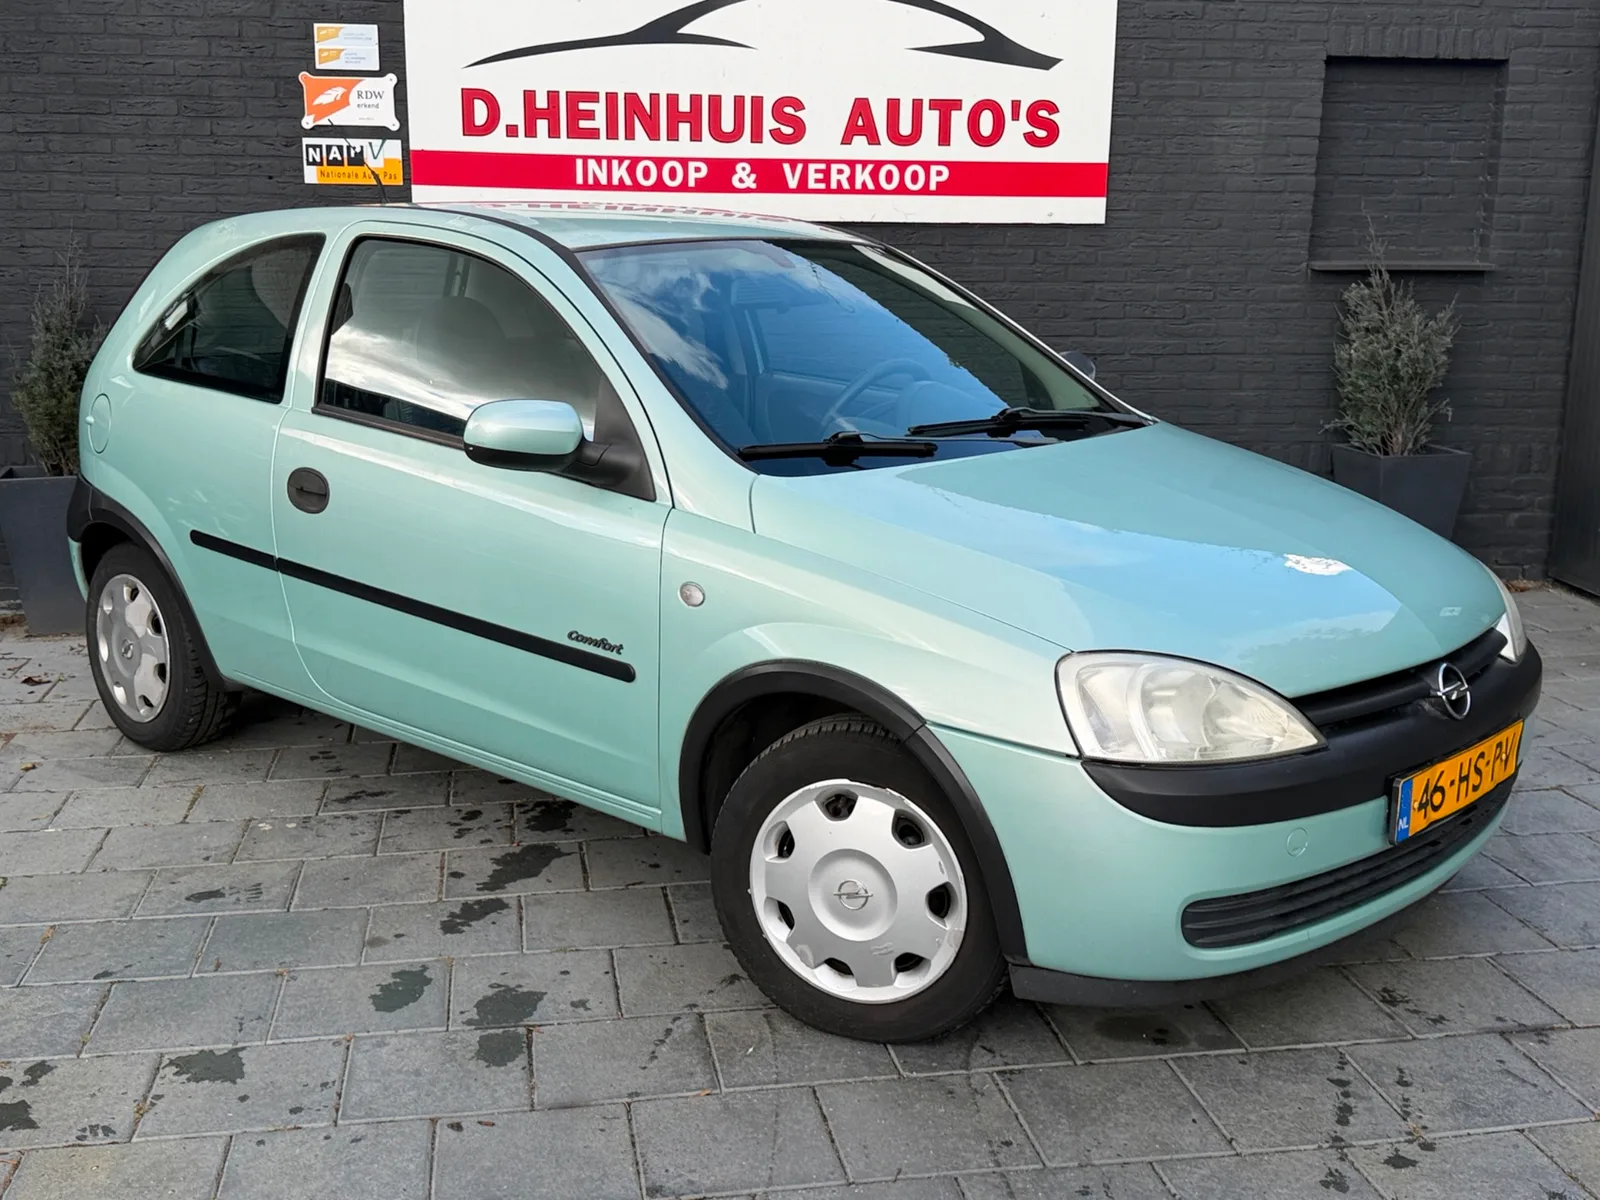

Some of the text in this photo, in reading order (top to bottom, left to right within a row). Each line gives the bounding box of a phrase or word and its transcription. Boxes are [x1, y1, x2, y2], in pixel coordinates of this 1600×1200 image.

[356, 90, 384, 100] RDW
[461, 87, 1061, 148] D.HEINHUIS AUTO'S
[320, 170, 359, 179] Nationale
[383, 171, 397, 180] Pas
[575, 157, 950, 191] INKOOP & VERKOOP
[567, 630, 624, 655] Comfort
[1398, 732, 1516, 831] NL 46-HS-PV
